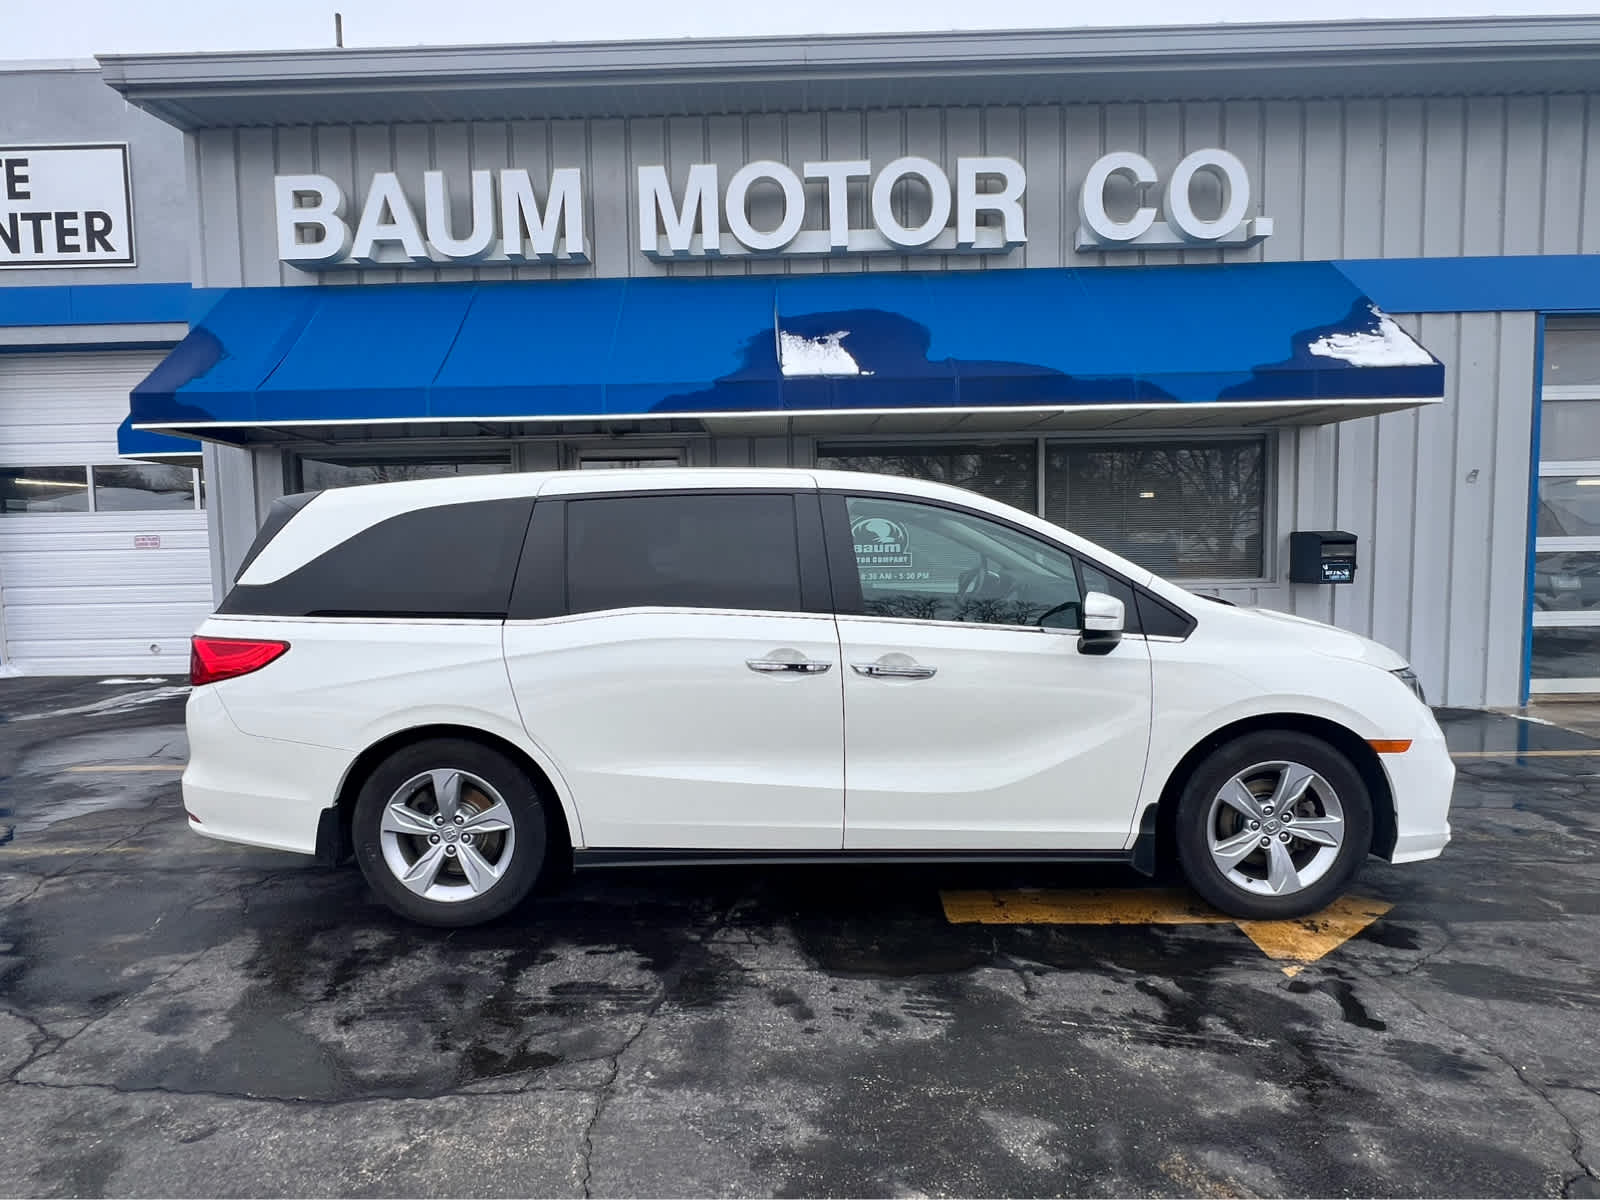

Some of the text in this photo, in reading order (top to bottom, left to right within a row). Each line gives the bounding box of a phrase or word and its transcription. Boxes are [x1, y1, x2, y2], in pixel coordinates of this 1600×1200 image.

[0, 158, 31, 200] E
[274, 148, 1274, 262] BAUM MOTOR CO.
[916, 571, 929, 579] PM
